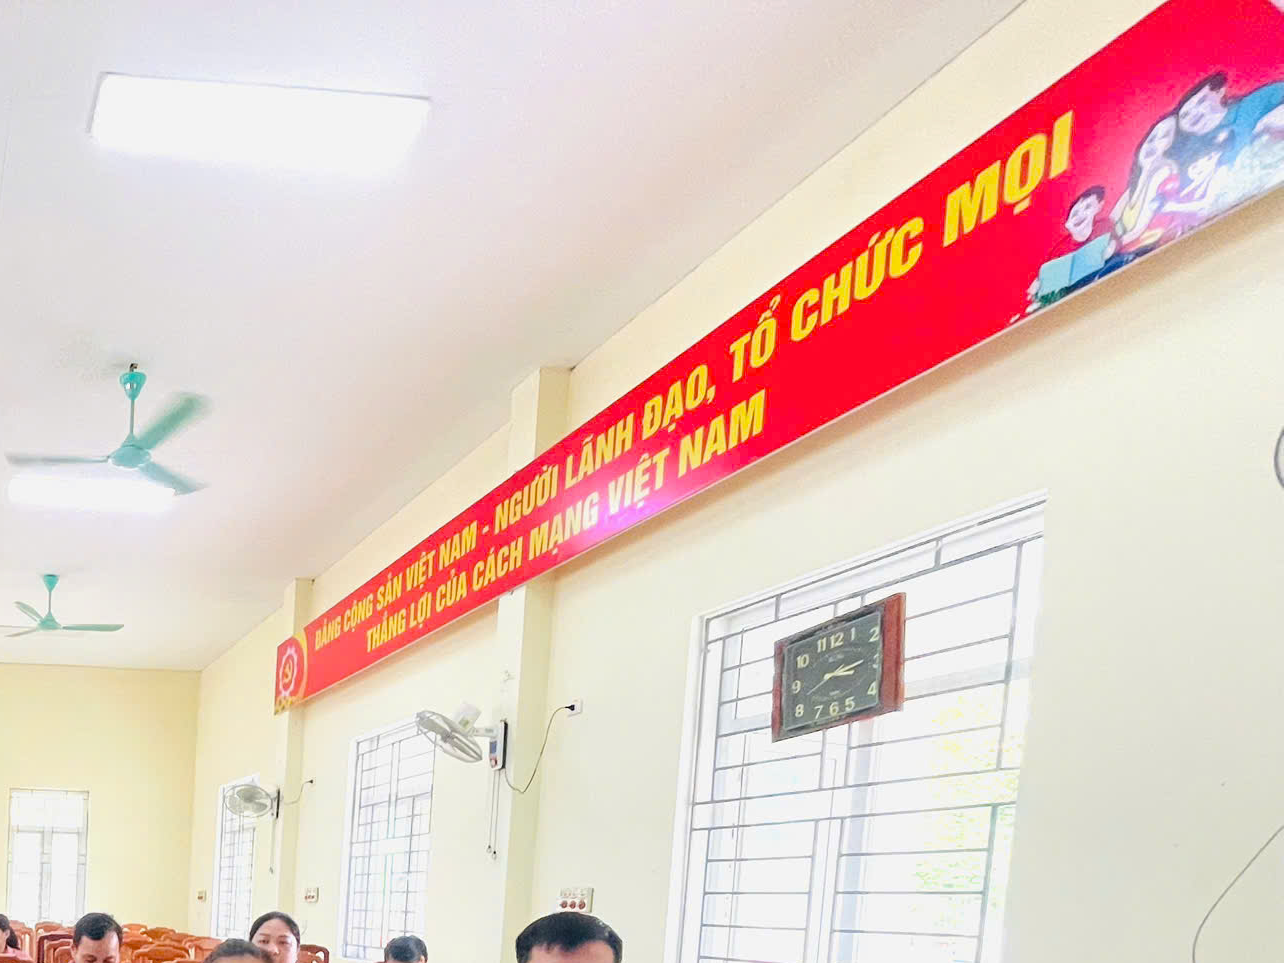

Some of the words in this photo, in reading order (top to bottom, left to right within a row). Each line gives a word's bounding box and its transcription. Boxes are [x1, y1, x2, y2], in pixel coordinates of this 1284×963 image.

[314, 616, 342, 651] ĐẢNG
[343, 593, 374, 632] CỘNG
[376, 572, 403, 611] SẢN
[406, 549, 436, 592] VIỆT
[438, 520, 478, 571] NAM
[494, 463, 559, 535] NGƯỜI
[564, 412, 635, 490] LÃNH
[641, 363, 717, 441] ĐẠO,
[729, 294, 782, 384] TỔ
[790, 216, 925, 342] CHỨC
[942, 109, 1075, 248] MỌI
[409, 591, 433, 629] LỢI
[436, 567, 468, 613] CỦA
[472, 536, 524, 592] CÁCH
[528, 491, 601, 561] MẠNG
[608, 447, 671, 516] VIỆT
[677, 387, 766, 479] NAM
[829, 632, 844, 649] 12
[868, 625, 880, 642] 2
[796, 654, 810, 669] 10
[792, 680, 801, 694] 9
[867, 681, 878, 696] 4
[795, 704, 804, 718] 8
[829, 701, 839, 717] 6
[844, 696, 856, 712] 5
[814, 705, 824, 720] 7
